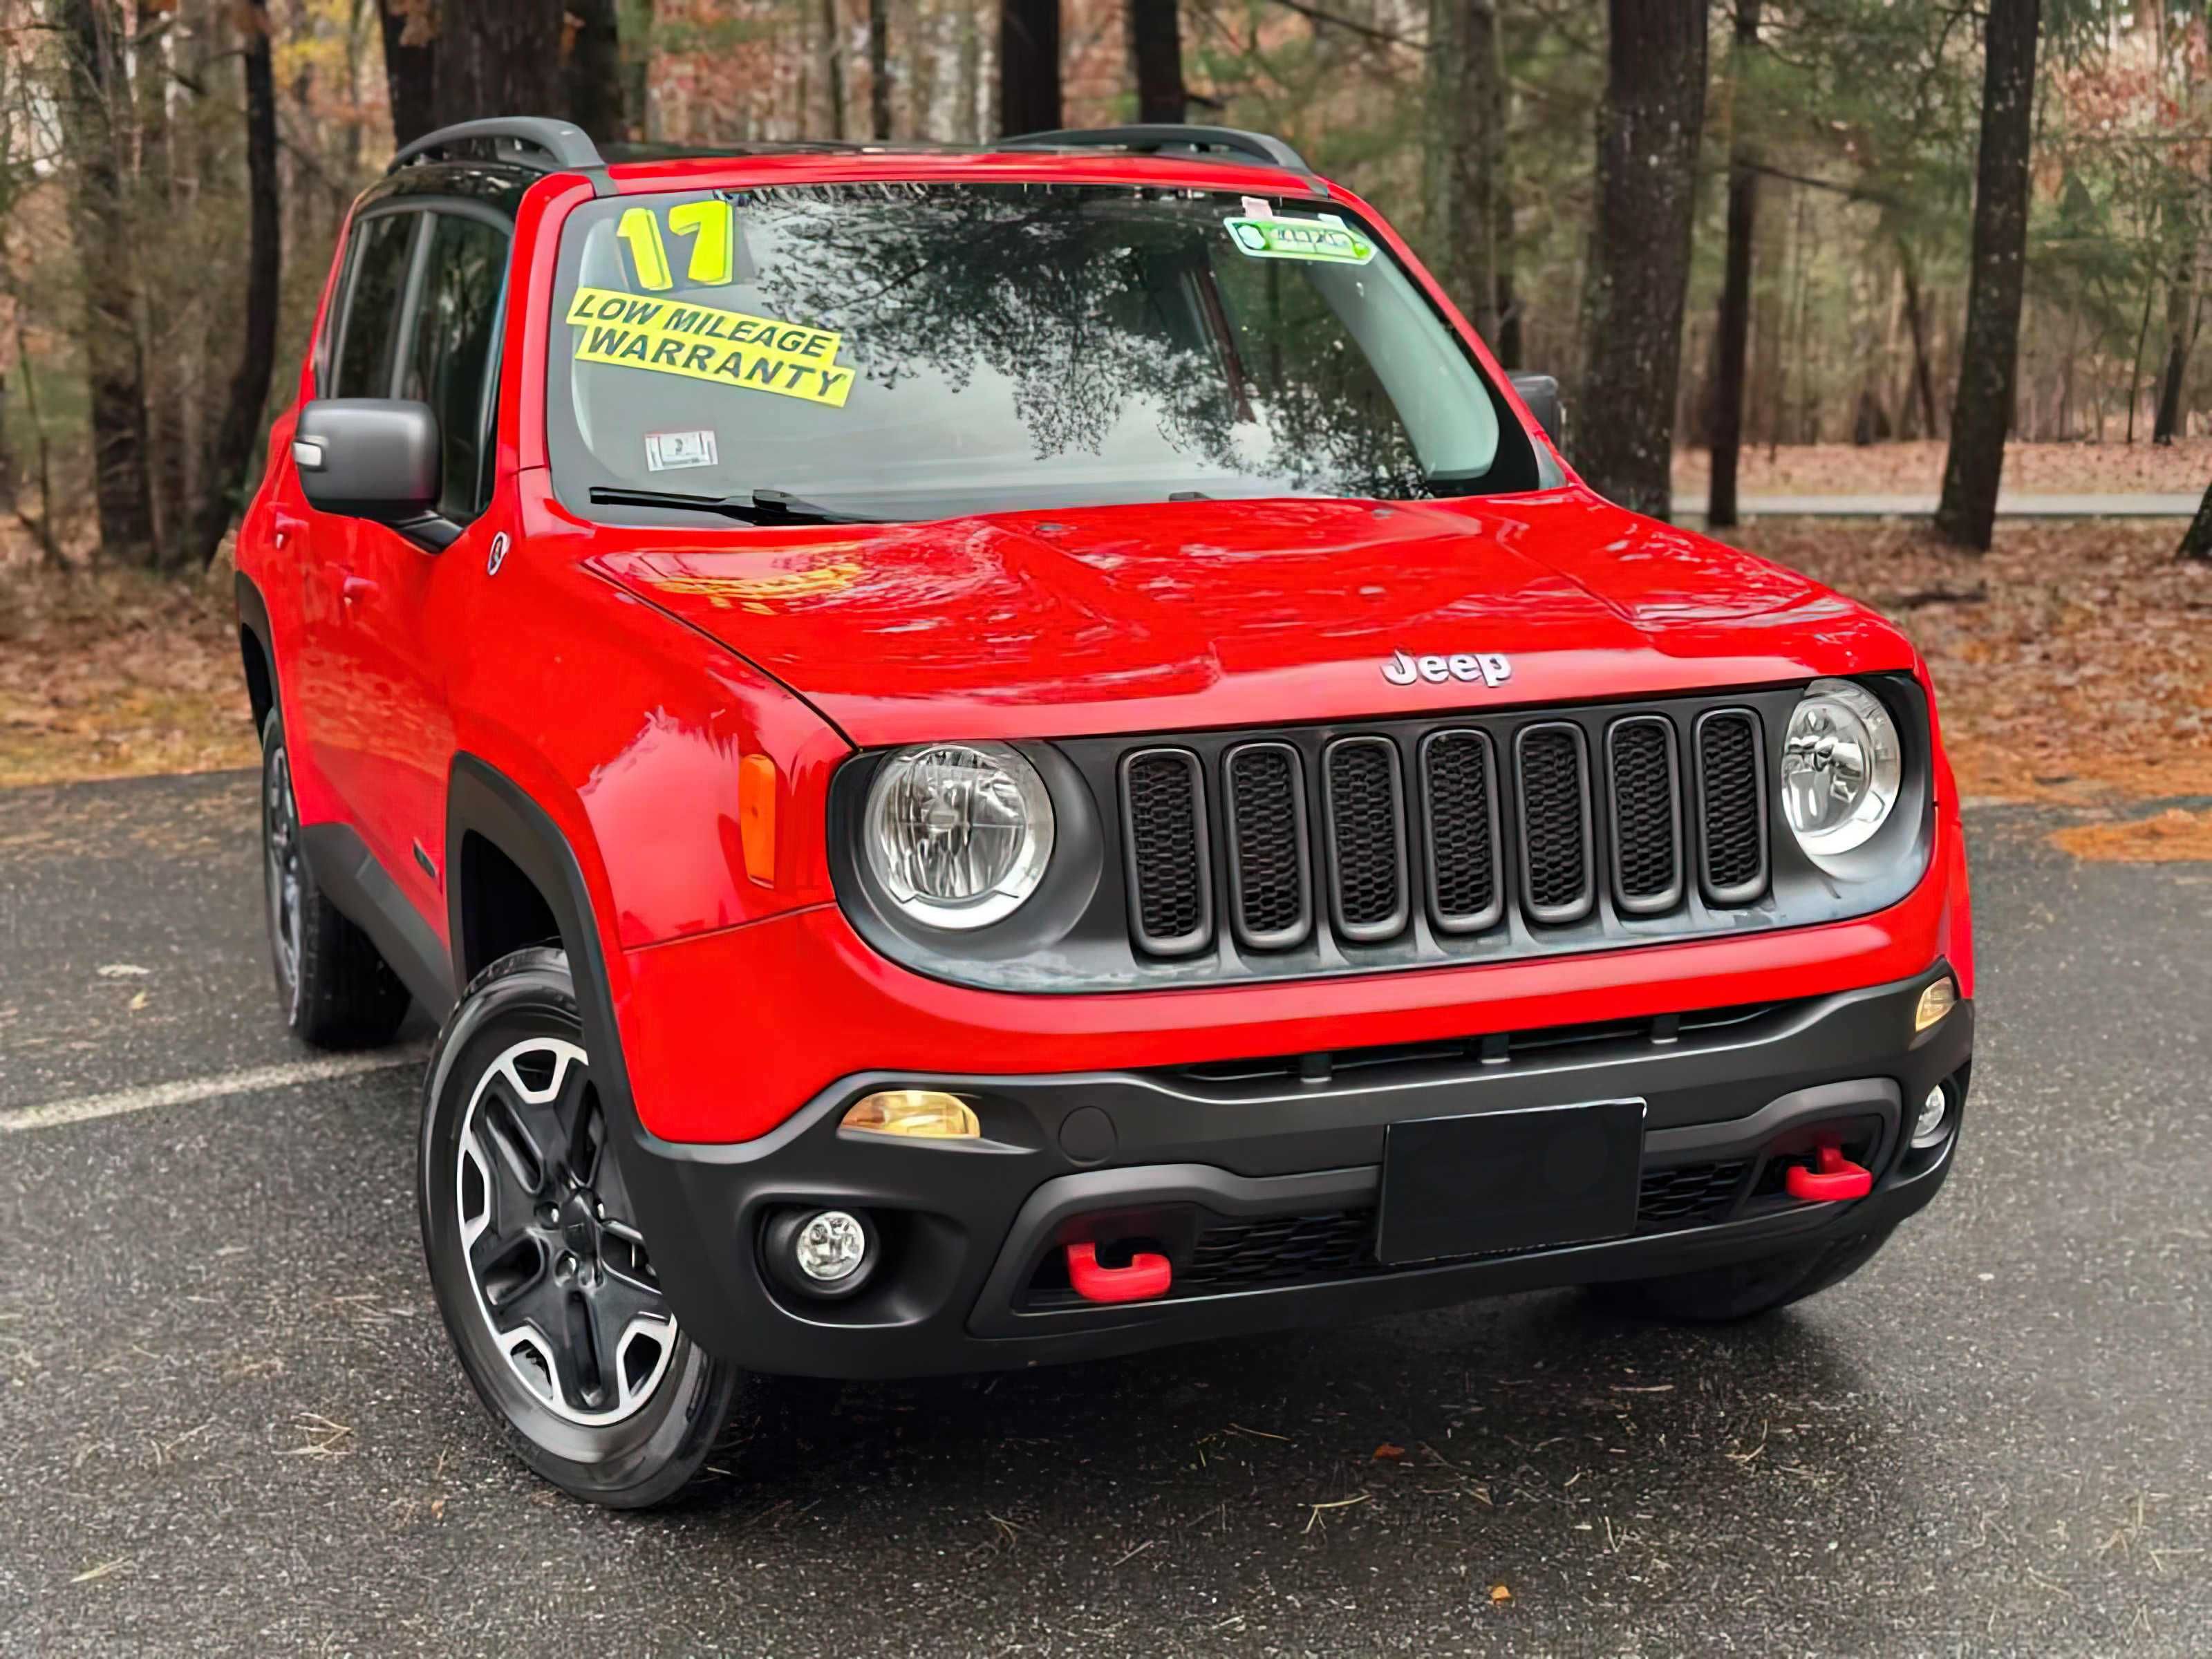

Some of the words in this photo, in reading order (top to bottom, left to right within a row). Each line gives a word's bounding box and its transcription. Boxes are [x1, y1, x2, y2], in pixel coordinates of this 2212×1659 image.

[617, 200, 733, 290] 17
[574, 294, 663, 325] LOW
[664, 308, 832, 358] MILEAGE
[588, 326, 847, 397] WARRANTY
[1380, 650, 1511, 688] Jeep
